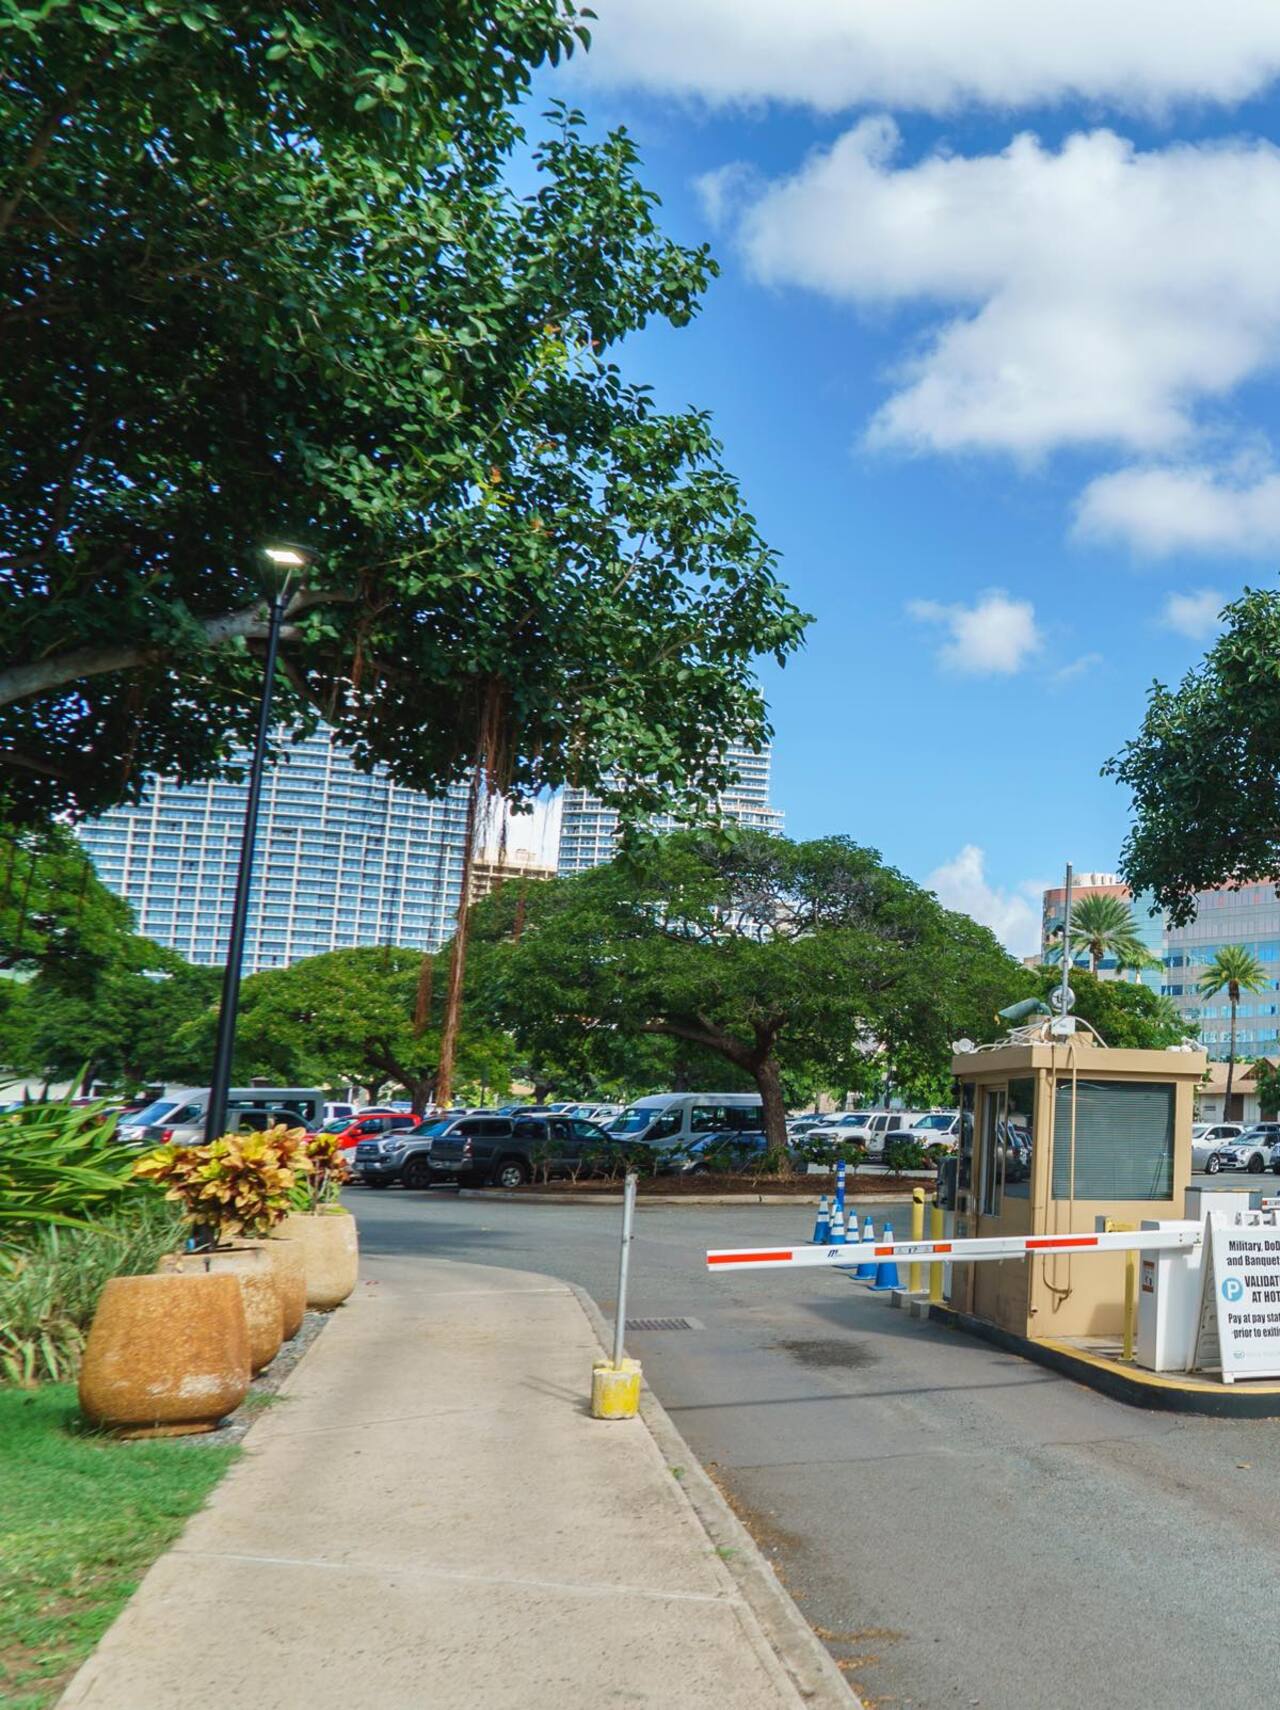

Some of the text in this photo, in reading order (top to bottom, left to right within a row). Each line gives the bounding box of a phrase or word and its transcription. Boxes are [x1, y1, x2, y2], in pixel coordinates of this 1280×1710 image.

[1264, 1240, 1280, 1251] DoD
[1227, 1256, 1243, 1266] and
[1252, 1291, 1262, 1303] AT
[1228, 1313, 1242, 1324] Pay
[1243, 1314, 1251, 1323] at
[1252, 1314, 1265, 1324] pay
[1233, 1328, 1252, 1339] prior
[1253, 1328, 1262, 1337] to
